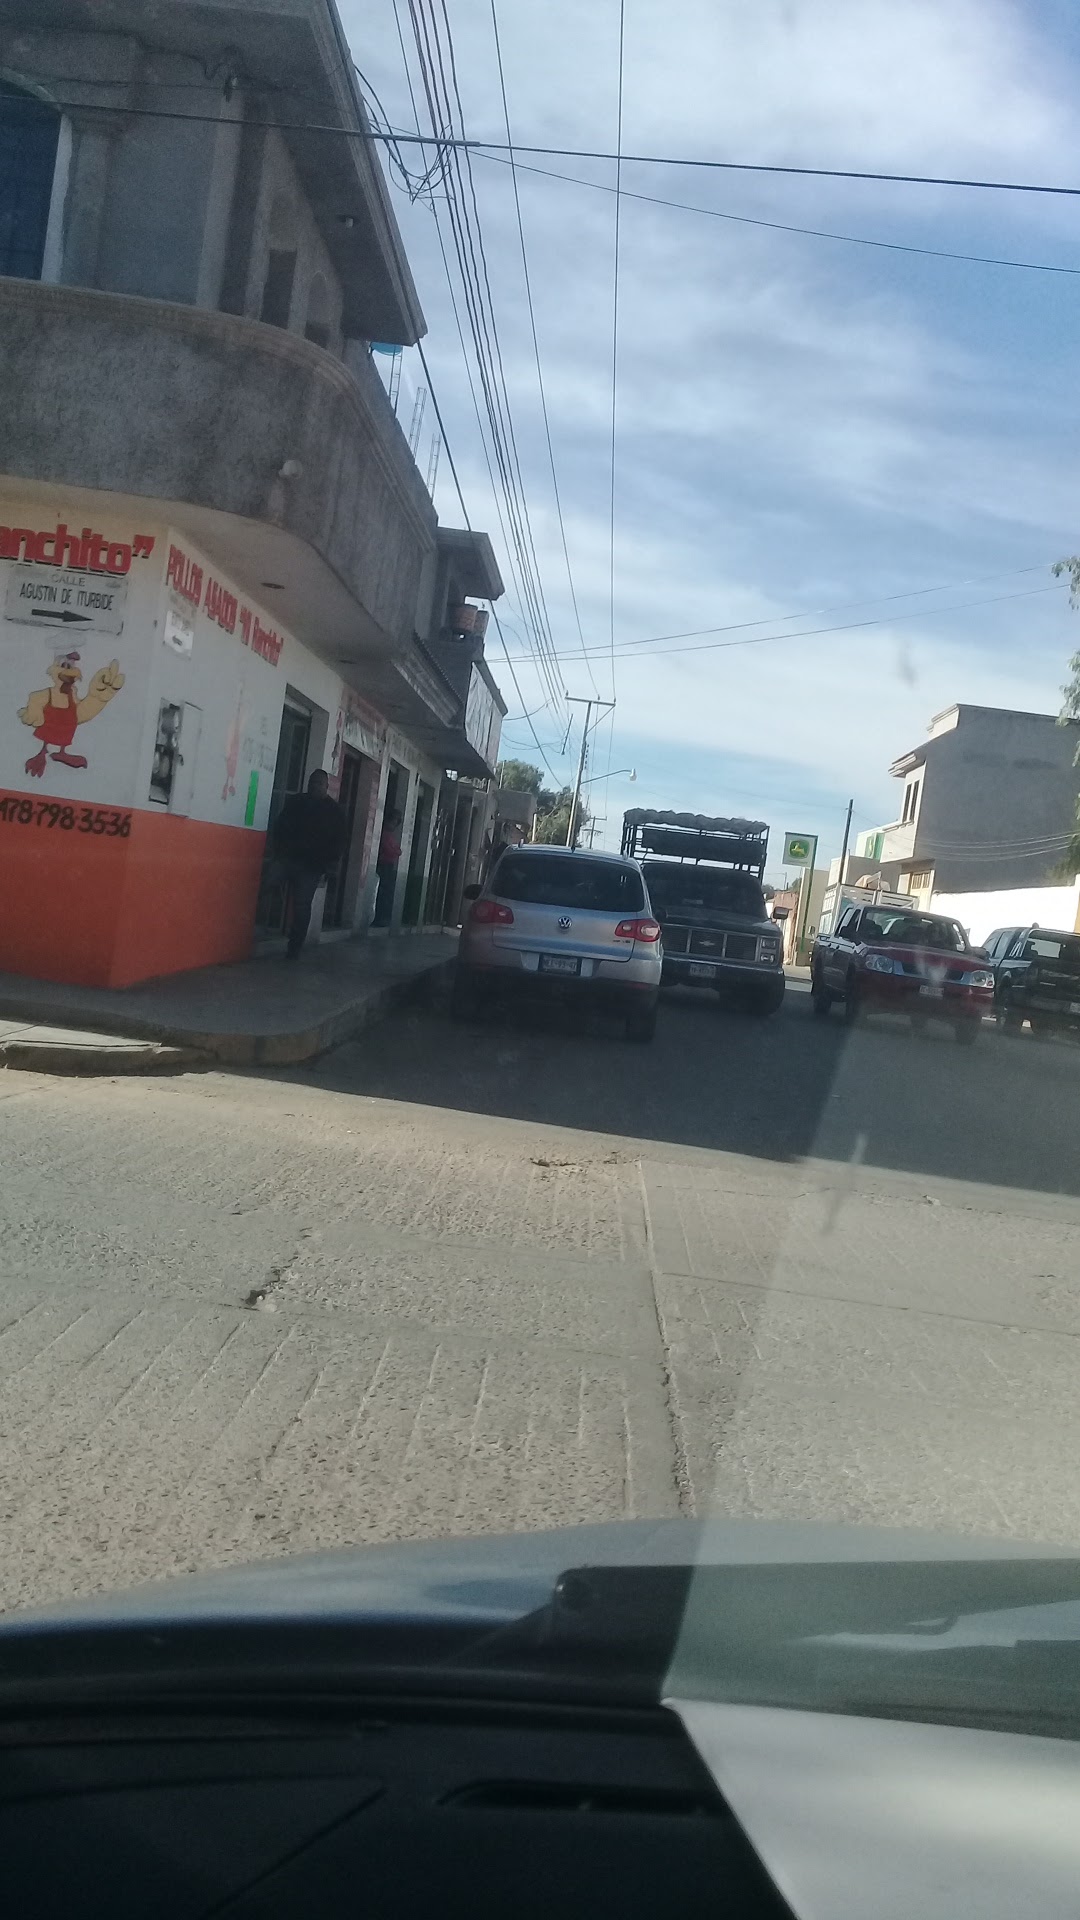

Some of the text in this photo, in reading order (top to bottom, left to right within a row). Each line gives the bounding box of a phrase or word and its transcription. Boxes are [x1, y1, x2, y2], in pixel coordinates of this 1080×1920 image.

[51, 573, 86, 588] CALLE
[165, 544, 203, 608] POLLOS
[20, 583, 115, 611] AGUSTIN DE ITURBIDE
